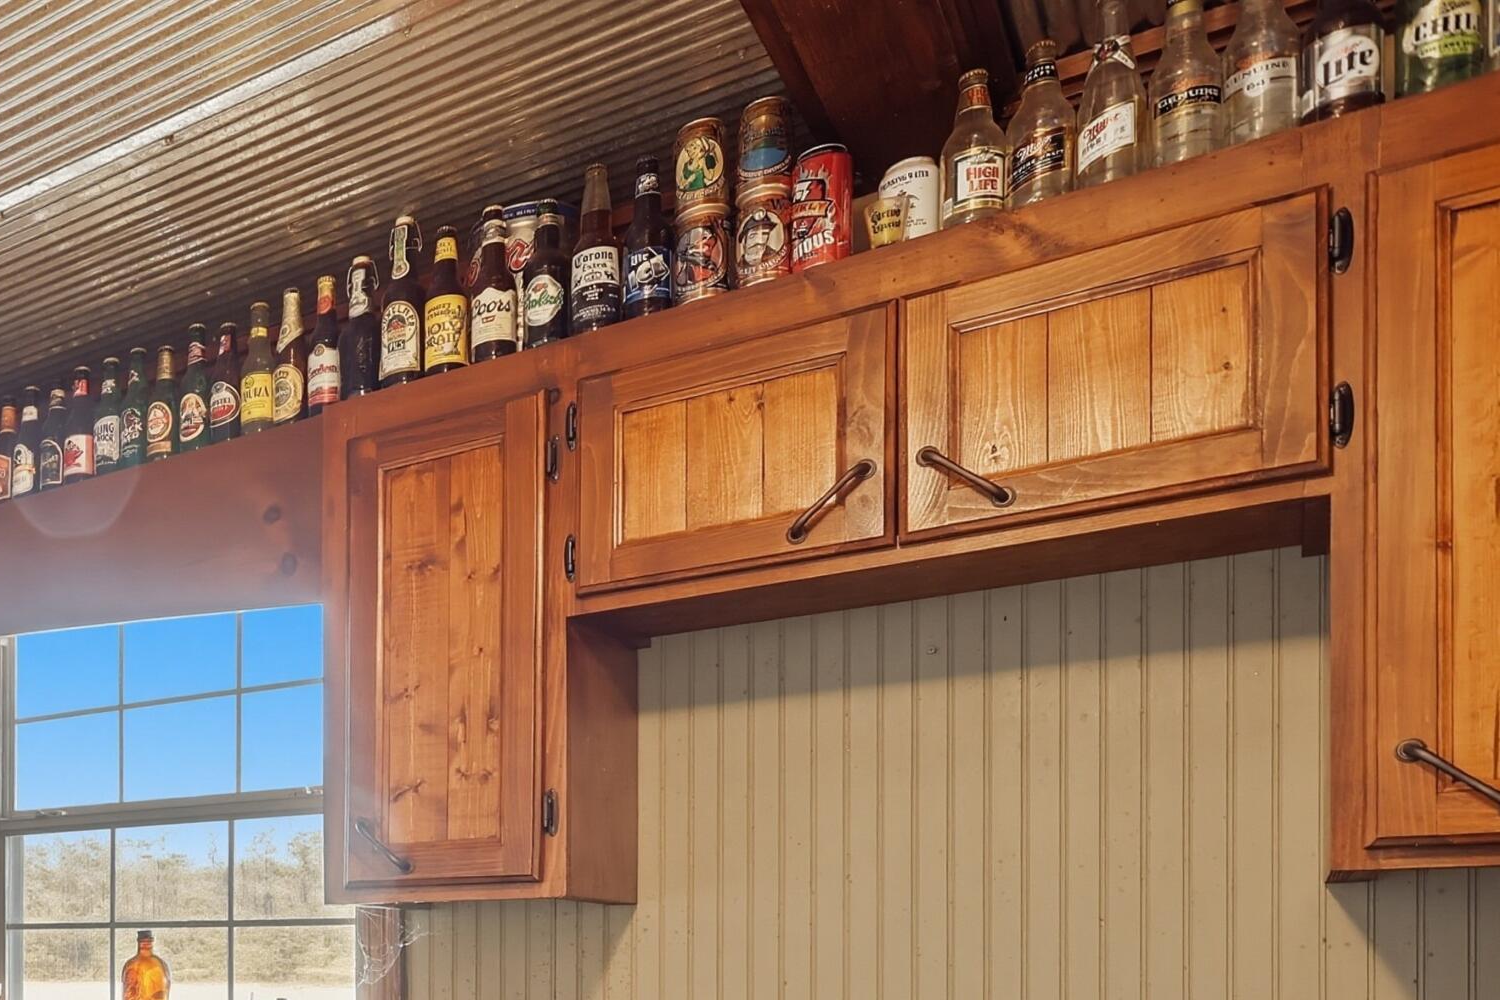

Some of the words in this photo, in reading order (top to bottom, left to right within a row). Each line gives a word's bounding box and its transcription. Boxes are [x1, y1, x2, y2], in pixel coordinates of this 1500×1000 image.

[1322, 48, 1375, 87] Lite
[967, 178, 999, 194] LIFE
[574, 249, 614, 269] Corona
[472, 299, 512, 318] Coors
